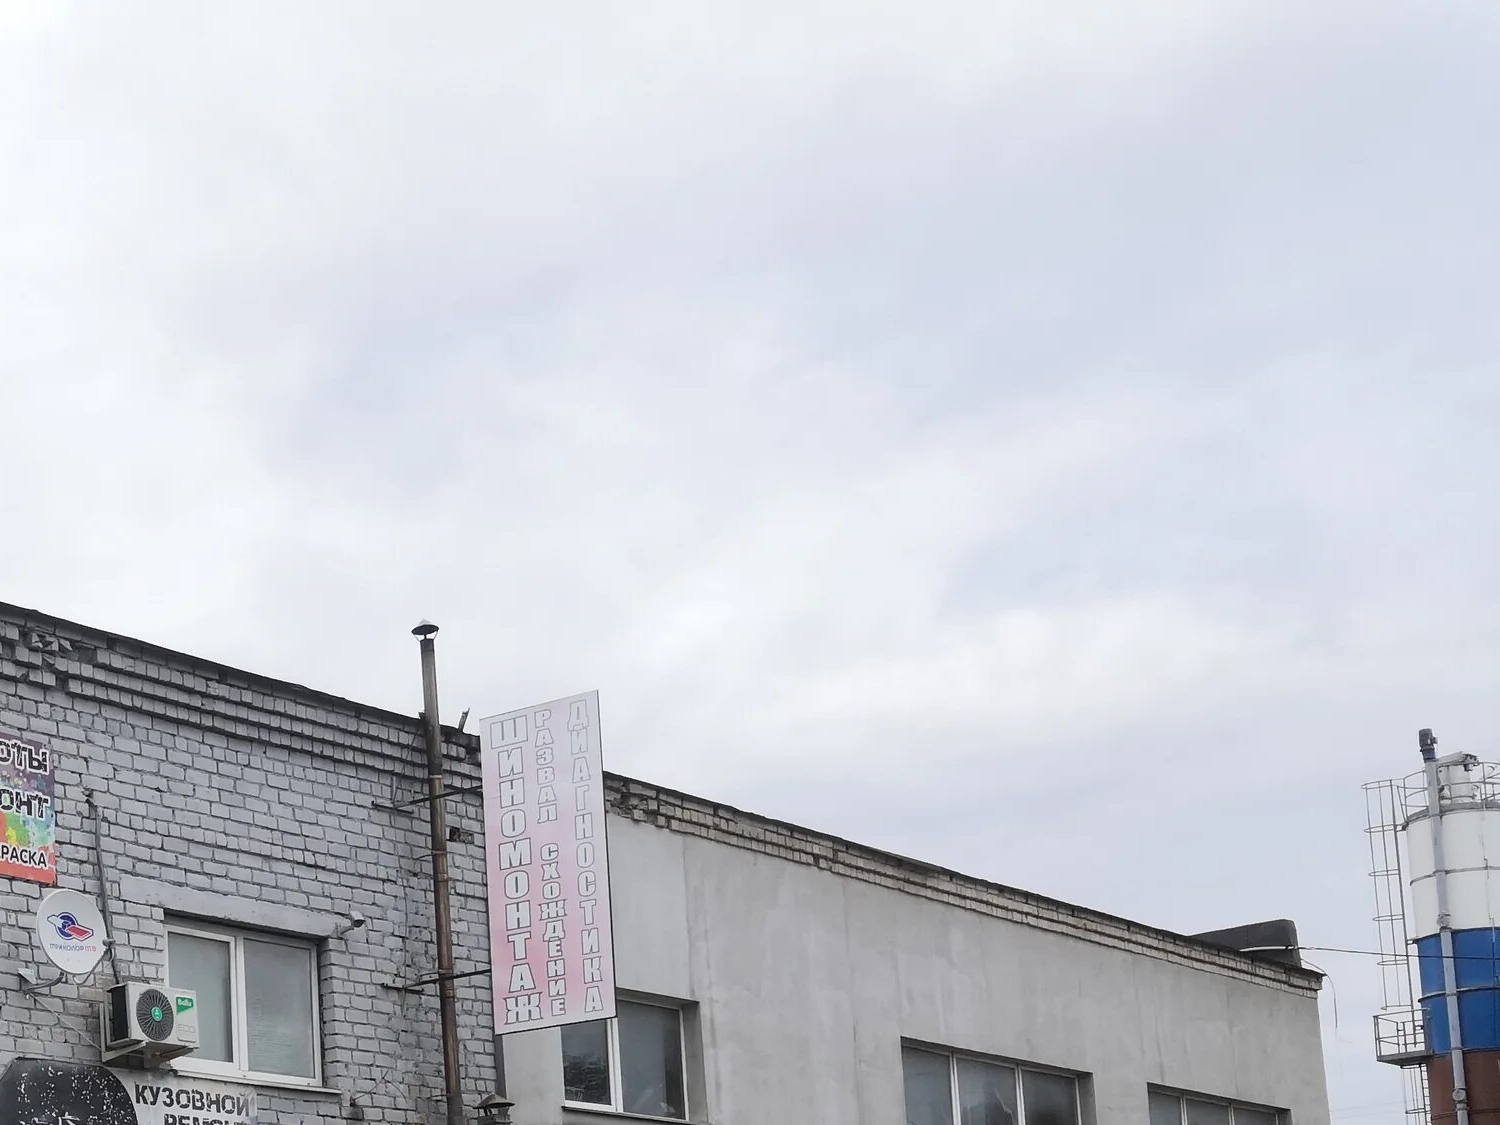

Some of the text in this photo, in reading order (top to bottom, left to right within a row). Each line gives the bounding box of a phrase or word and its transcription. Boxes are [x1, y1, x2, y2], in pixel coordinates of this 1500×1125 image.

[490, 715, 543, 1025] ШИНОМОНТАЖ
[534, 709, 567, 1016] РАЗВАЛ СХОЖДЕНИЕ
[567, 699, 604, 1013] ДИАГНОСТИКА
[134, 1083, 249, 1117] КУЗОВНОЙ
